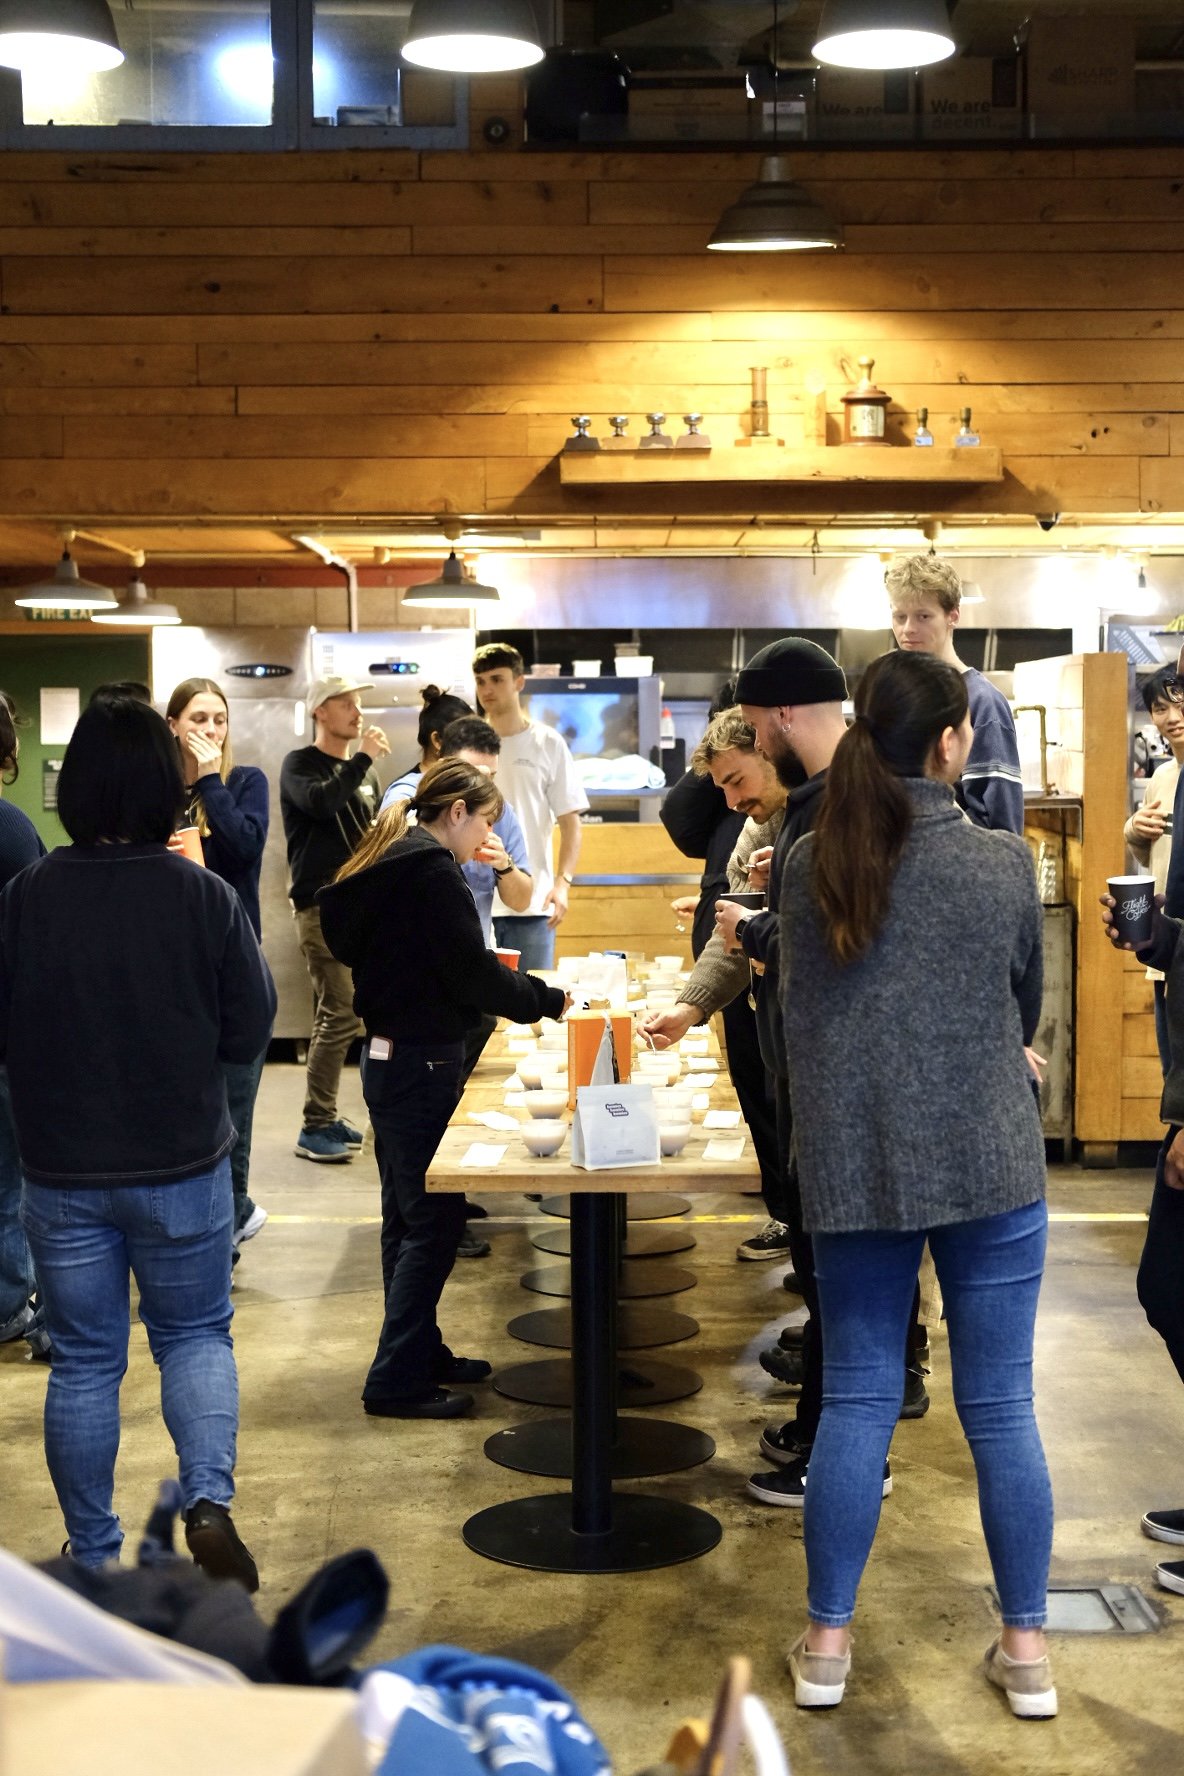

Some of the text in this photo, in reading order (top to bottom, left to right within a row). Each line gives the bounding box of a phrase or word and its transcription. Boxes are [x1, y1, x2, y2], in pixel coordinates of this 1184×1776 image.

[931, 98, 991, 114] We are
[32, 607, 65, 620] FIRE
